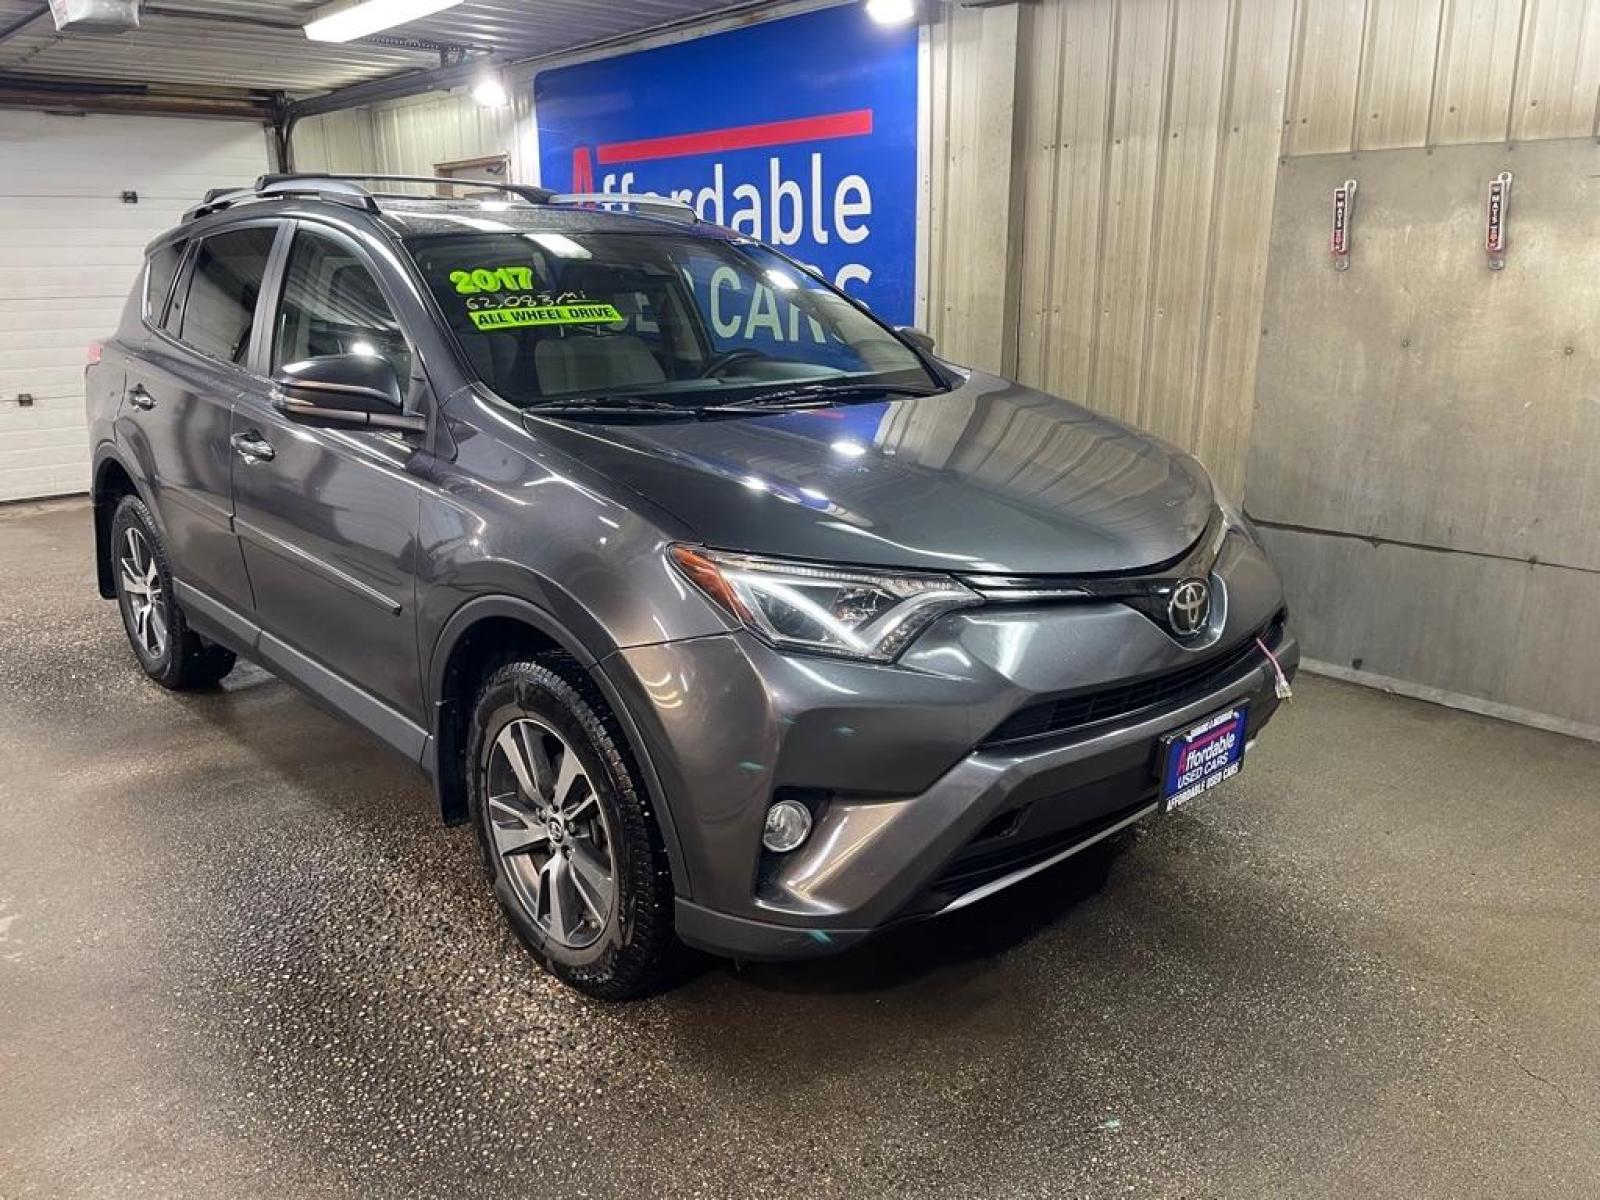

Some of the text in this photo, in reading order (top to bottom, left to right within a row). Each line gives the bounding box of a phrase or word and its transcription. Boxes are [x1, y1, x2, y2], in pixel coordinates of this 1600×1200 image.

[573, 147, 872, 244] Affdable
[450, 266, 533, 293] 2017
[478, 306, 612, 326] ALL WHEEL DRIVE
[1177, 752, 1229, 789] USED CARS
